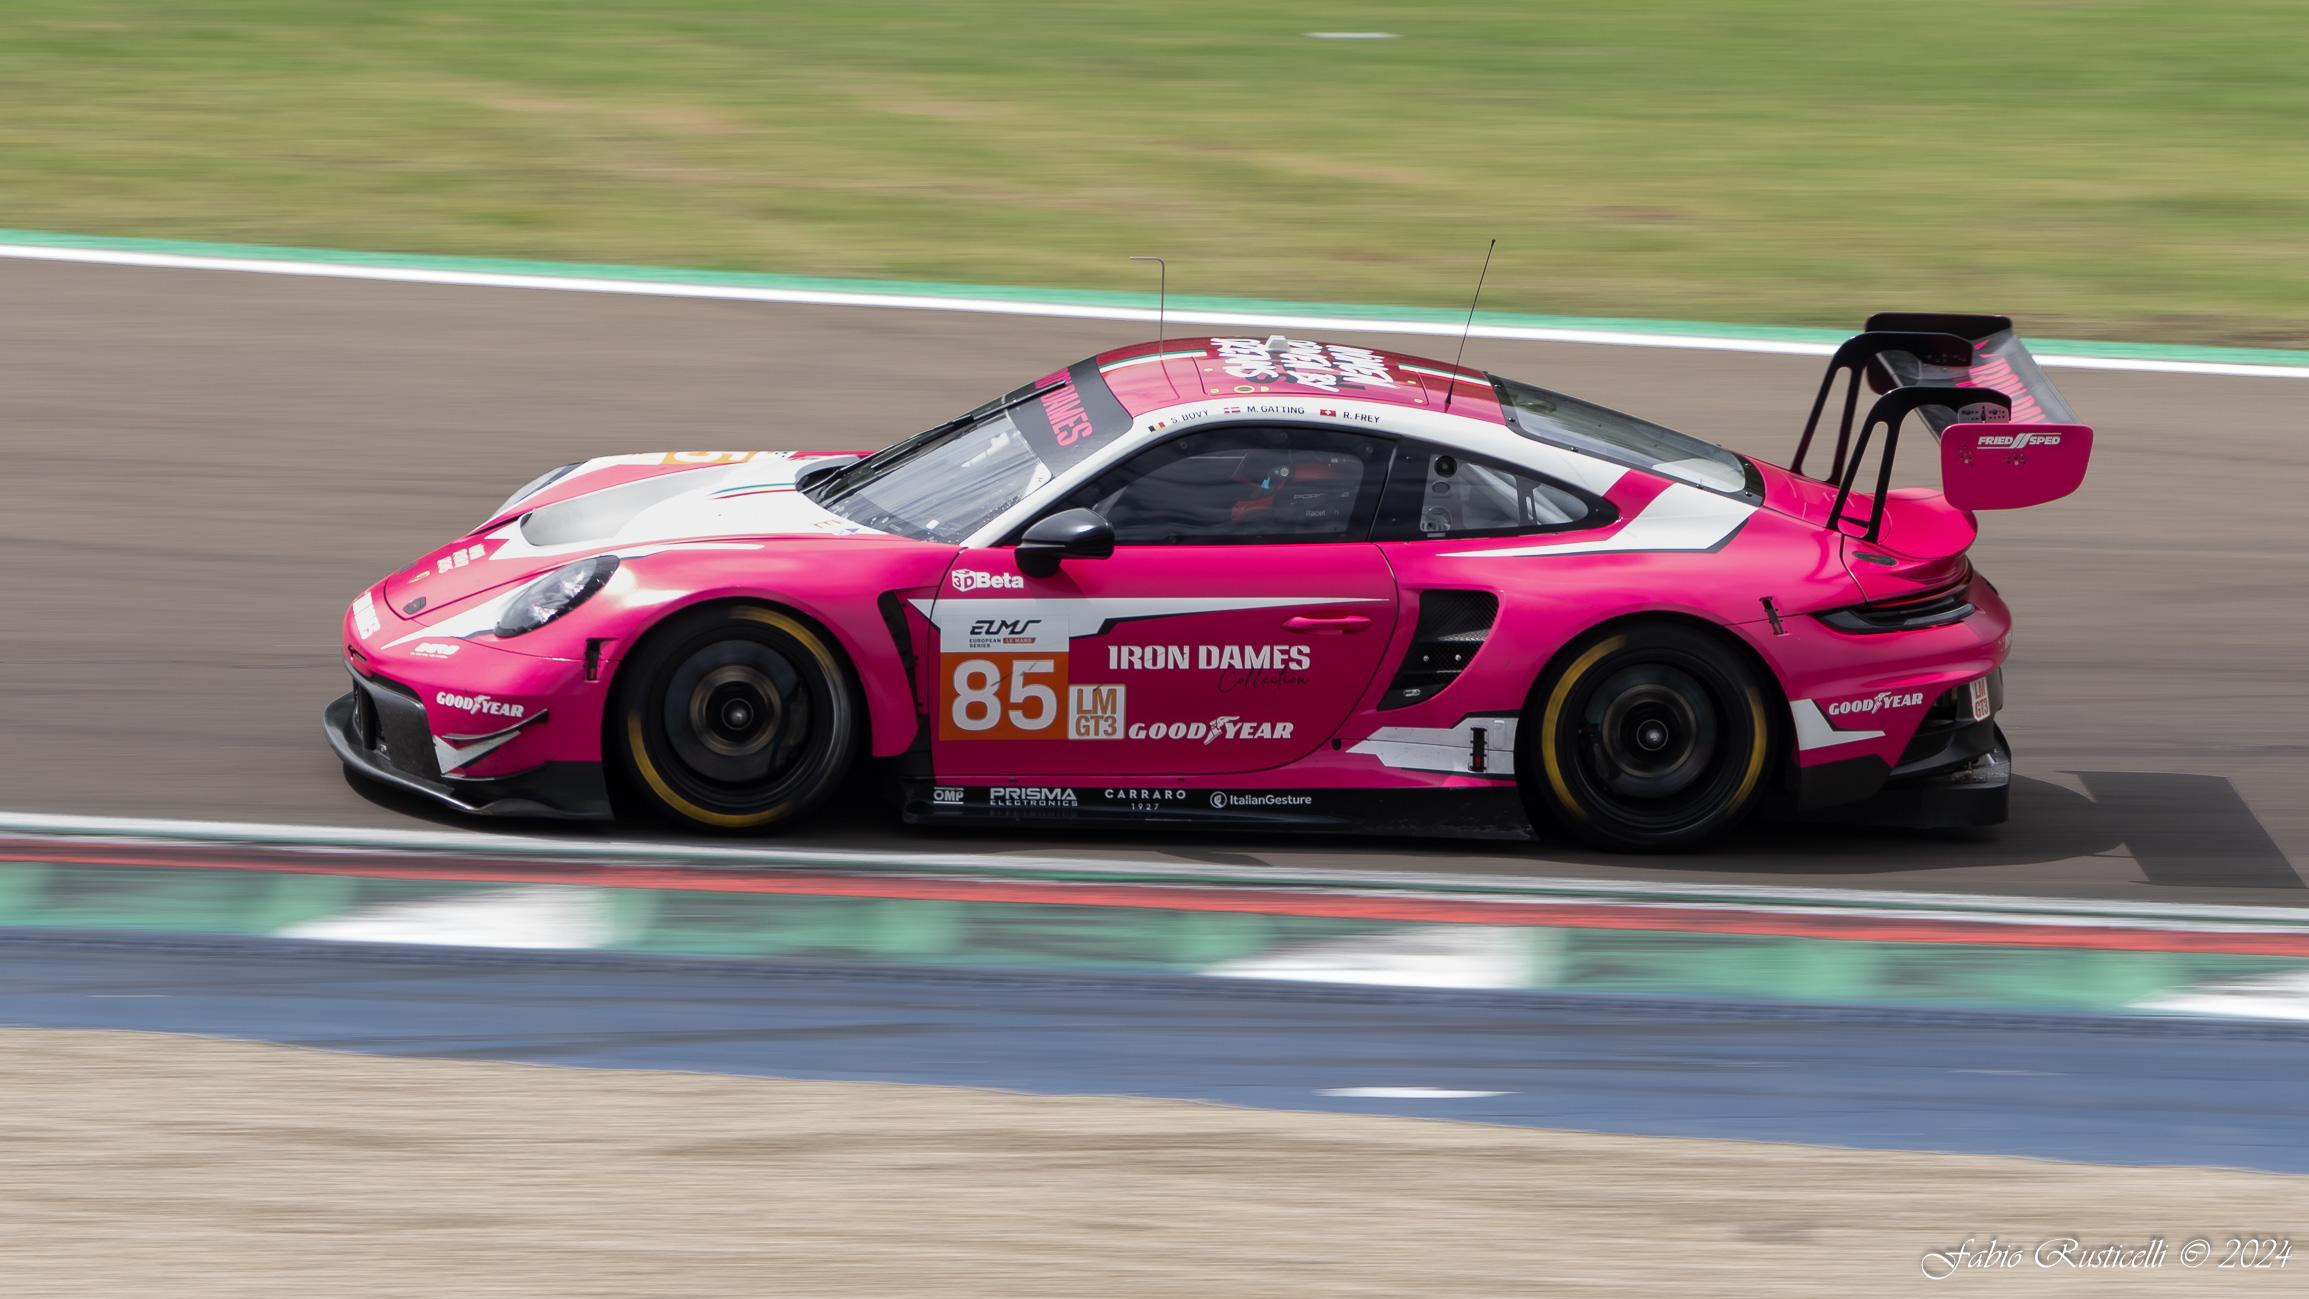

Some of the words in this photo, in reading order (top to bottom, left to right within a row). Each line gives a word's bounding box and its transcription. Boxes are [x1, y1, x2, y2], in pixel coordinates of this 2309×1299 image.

[1040, 384, 1093, 446] DAMES
[1171, 416, 1181, 424] S.
[1183, 409, 1209, 422] BOVY
[1247, 405, 1259, 413] M.
[1261, 405, 1305, 415] GATTING
[1343, 411, 1353, 420] R.
[1355, 413, 1380, 424] FREY
[1108, 645, 1190, 670] IRON
[1198, 645, 1311, 670] DAMES
[1217, 664, 1311, 693] Collection
[951, 659, 1057, 731] 85
[1973, 678, 1986, 700] LM
[1076, 688, 1117, 715] LM
[1974, 697, 1989, 718] GT3
[1075, 715, 1117, 737] GT3
[933, 790, 964, 801] OMP
[990, 787, 1077, 800] PRISMA
[1104, 789, 1187, 799] CARRARO
[1229, 794, 1312, 806] ItalianGesture
[1131, 803, 1160, 811] 1927
